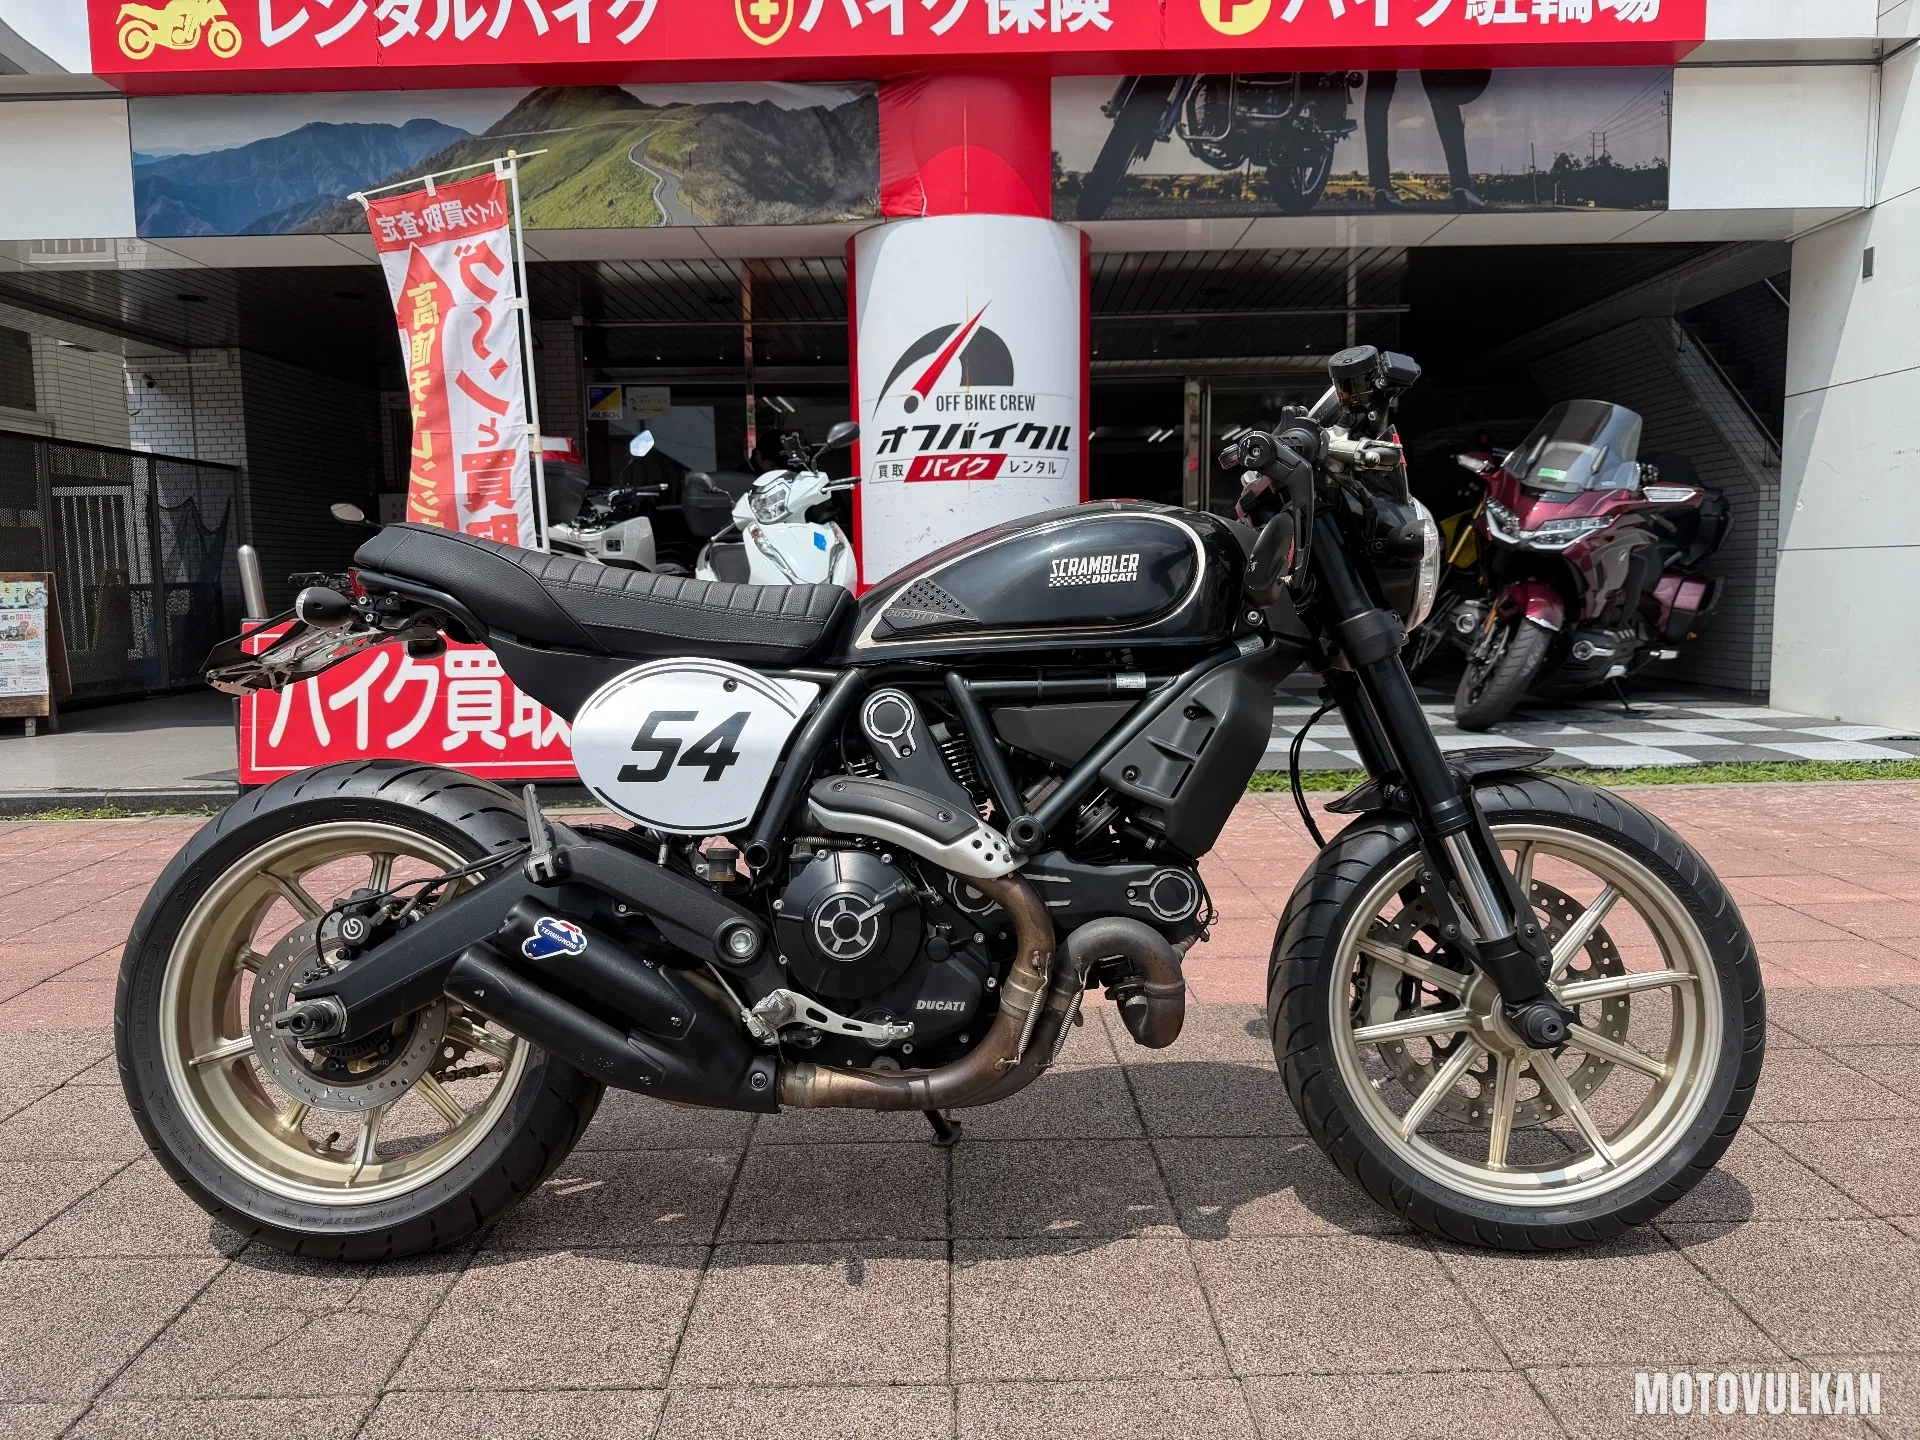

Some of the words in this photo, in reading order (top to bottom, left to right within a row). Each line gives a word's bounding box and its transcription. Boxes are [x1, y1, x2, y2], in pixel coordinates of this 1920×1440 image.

[936, 394, 960, 412] OFF
[964, 394, 996, 411] BIKE
[1000, 394, 1035, 412] CREW
[876, 422, 1072, 455] オフバイクル
[878, 463, 904, 479] 買取
[919, 457, 991, 478] バイク
[1009, 460, 1057, 474] レンタル
[1049, 554, 1140, 577] SCRAMBLER
[1091, 572, 1138, 584] DUCATI
[886, 609, 927, 621] DUCATI
[617, 711, 752, 782] 54
[541, 927, 577, 949] TERMIGNONI
[916, 1000, 965, 1011] DUCATI
